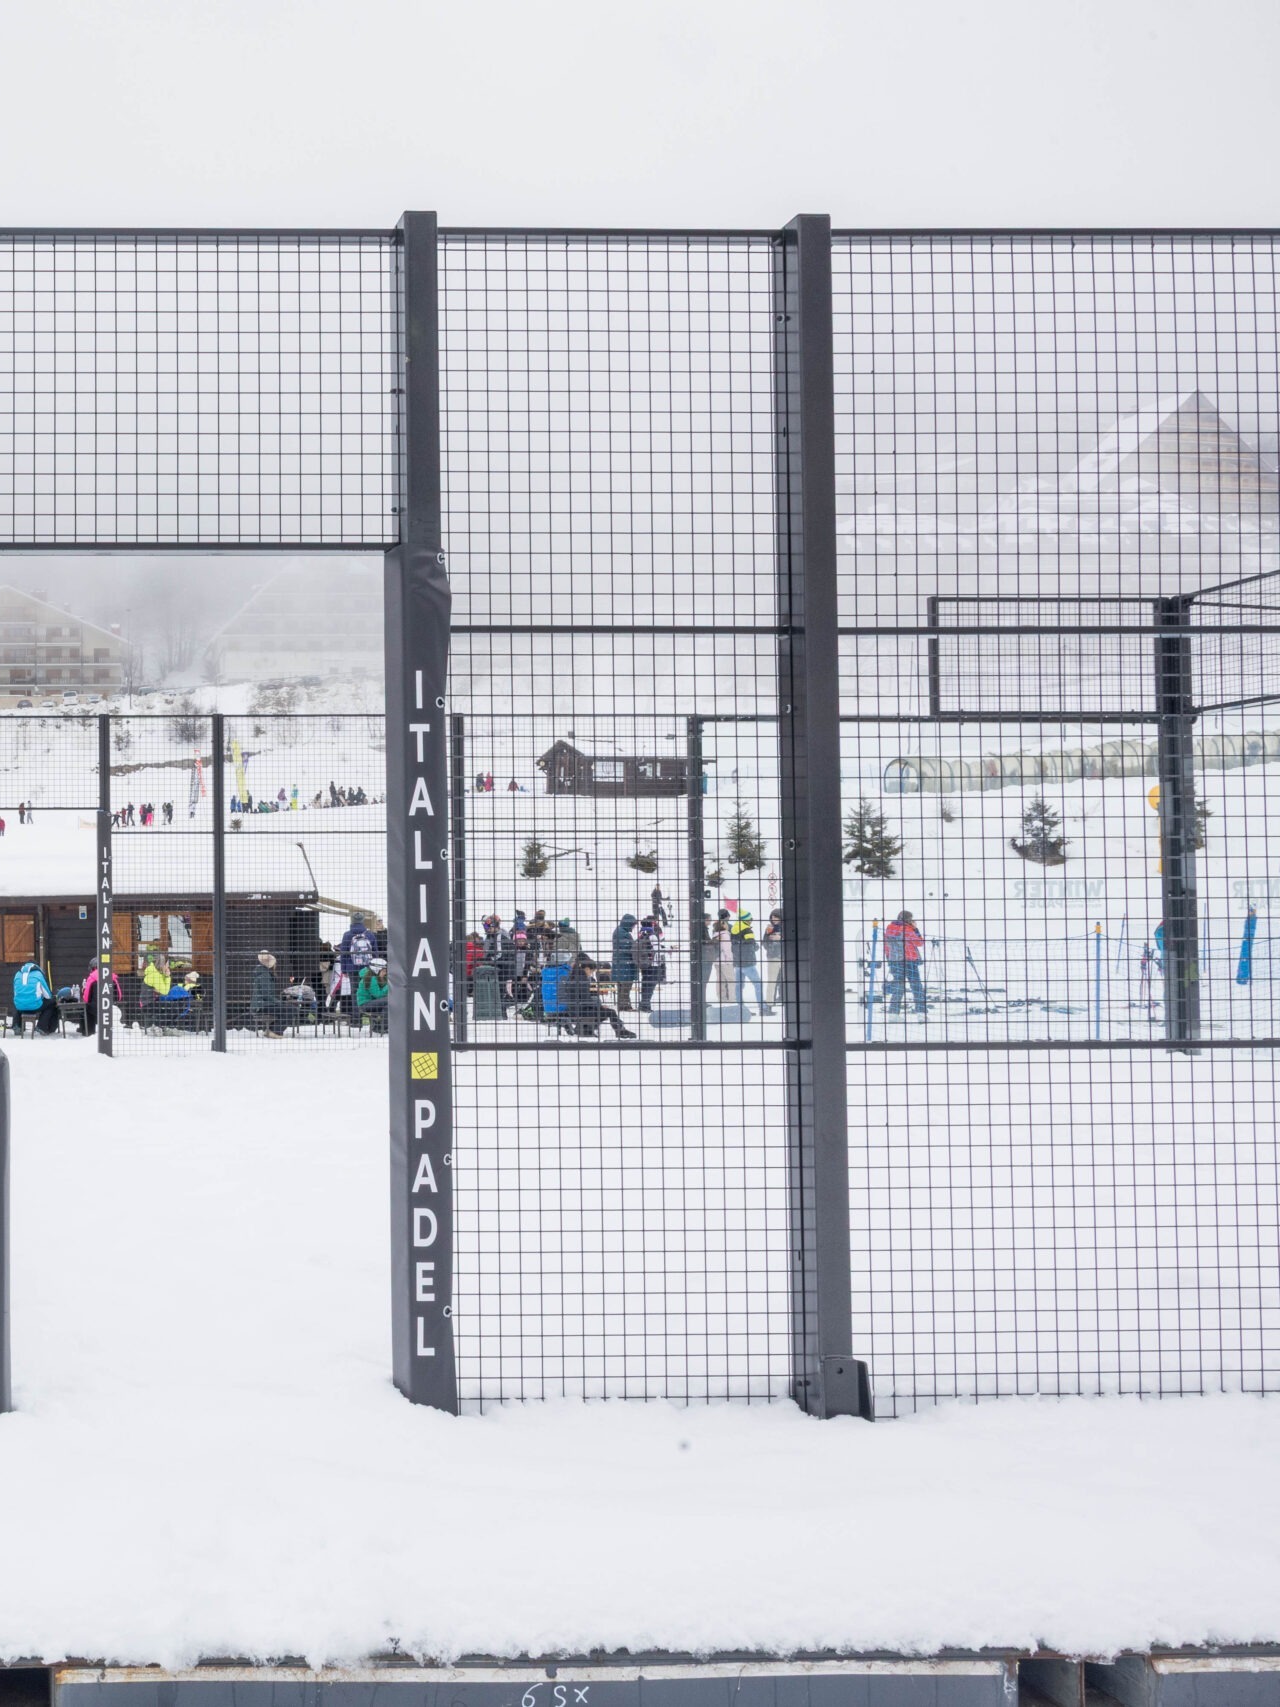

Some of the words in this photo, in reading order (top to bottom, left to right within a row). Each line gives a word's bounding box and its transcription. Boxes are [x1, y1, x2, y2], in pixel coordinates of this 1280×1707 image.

[101, 846, 110, 949] ITALIAN
[408, 670, 437, 1031] ITALIAN
[101, 967, 110, 1040] PADEL
[411, 1100, 438, 1356] PADEL
